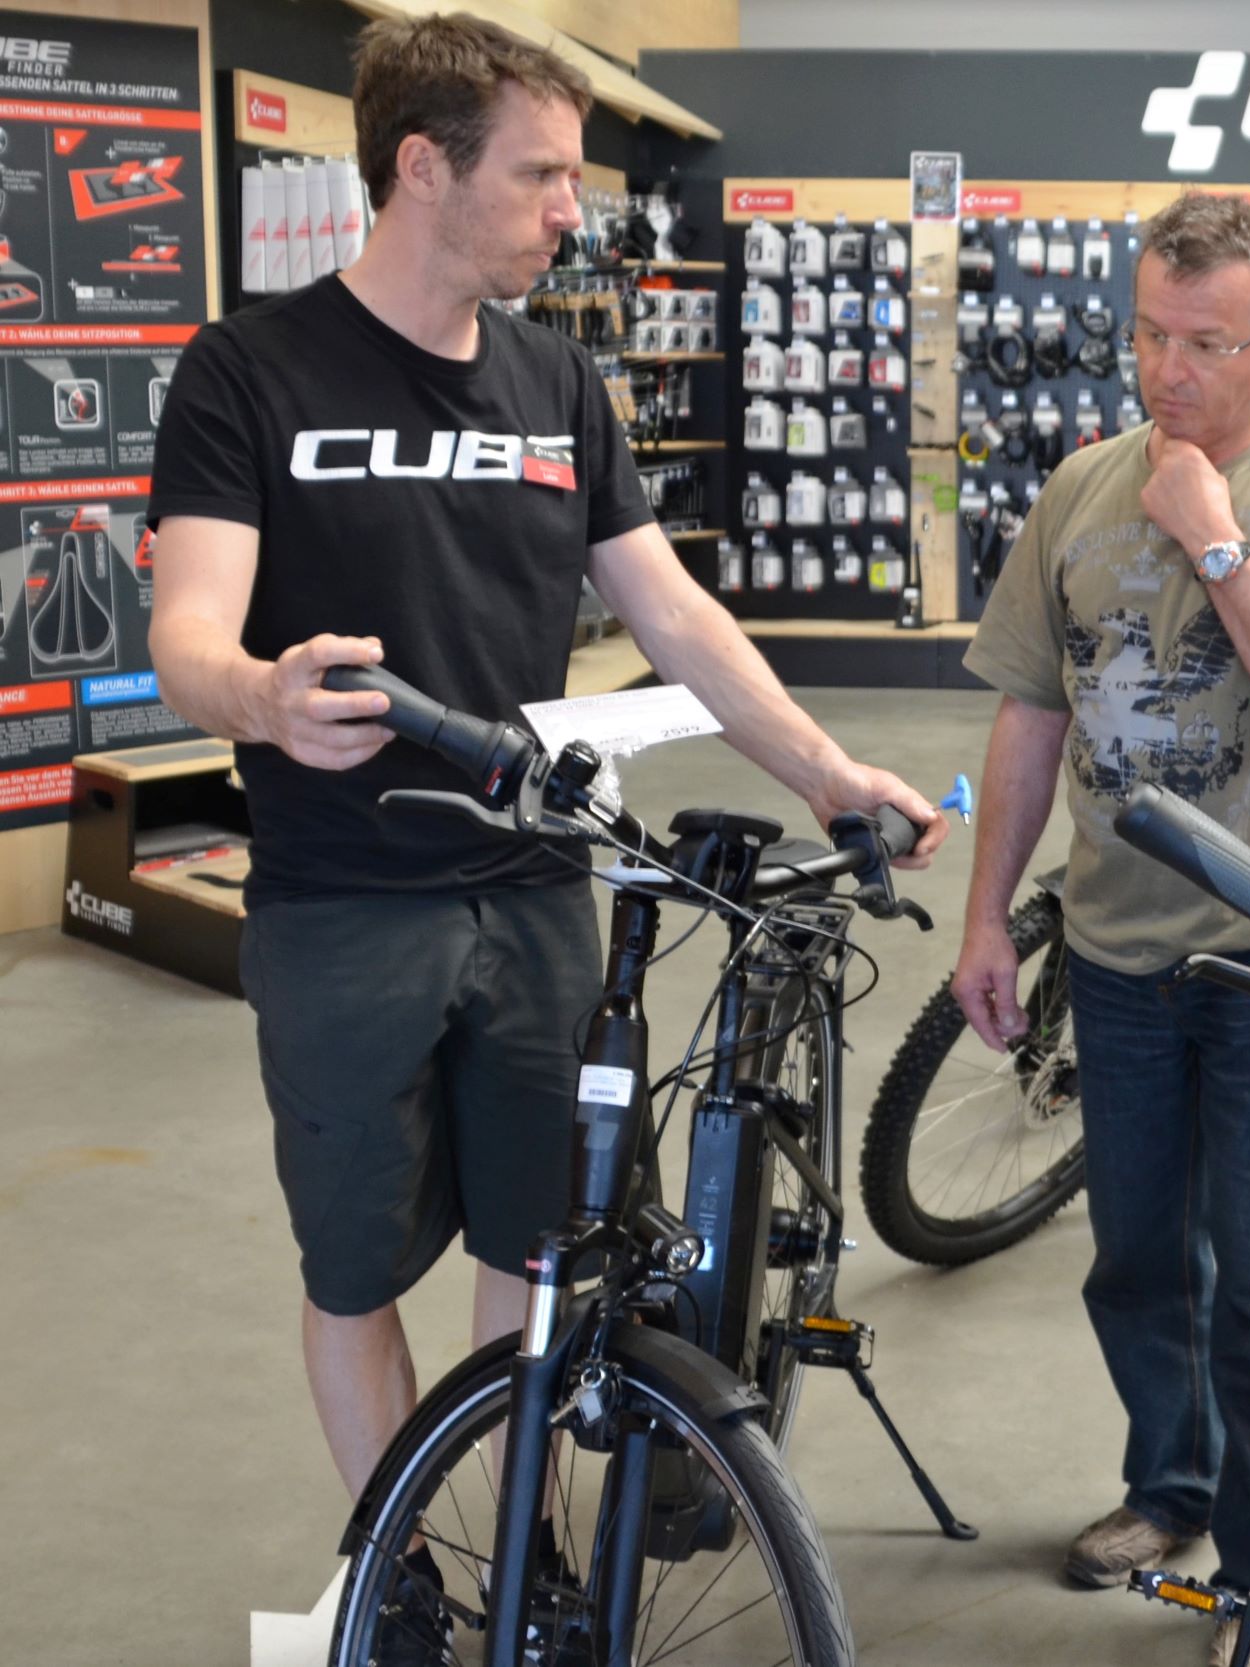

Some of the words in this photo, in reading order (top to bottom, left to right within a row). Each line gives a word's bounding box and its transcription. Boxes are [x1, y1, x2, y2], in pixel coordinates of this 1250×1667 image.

[0, 36, 71, 64] BE
[7, 61, 64, 77] FINDER
[52, 79, 93, 95] SATTEL
[95, 82, 107, 96] IN
[109, 83, 117, 96] 3
[118, 84, 179, 100] SCHRITTEN
[90, 678, 135, 692] NATURAL
[80, 893, 132, 926] CUBE
